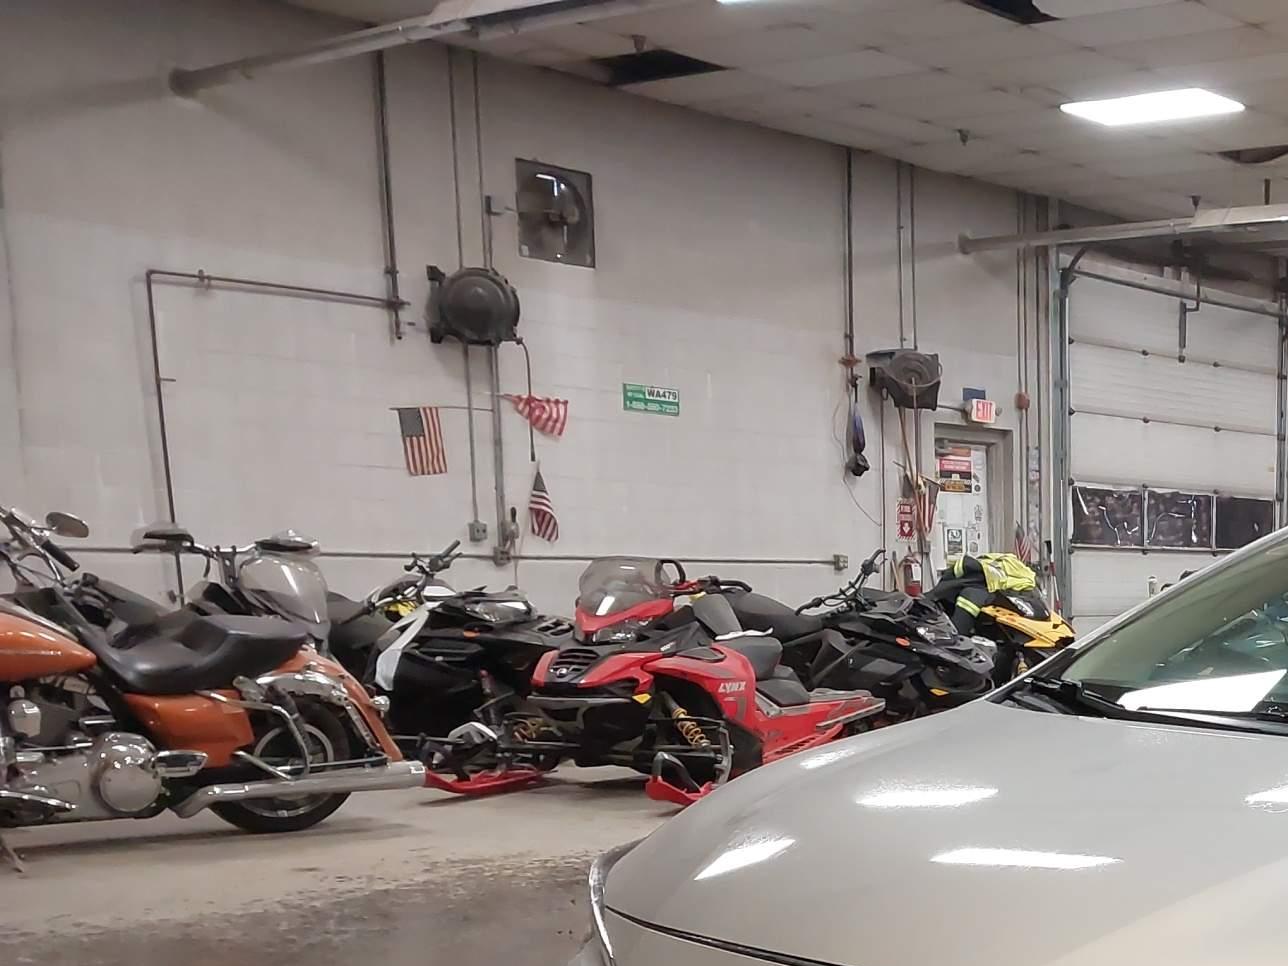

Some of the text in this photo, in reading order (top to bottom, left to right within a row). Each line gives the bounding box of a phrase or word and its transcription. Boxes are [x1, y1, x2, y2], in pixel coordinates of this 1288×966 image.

[646, 389, 678, 401] WA479
[975, 400, 993, 420] EXIT
[718, 681, 746, 694] LYNX
